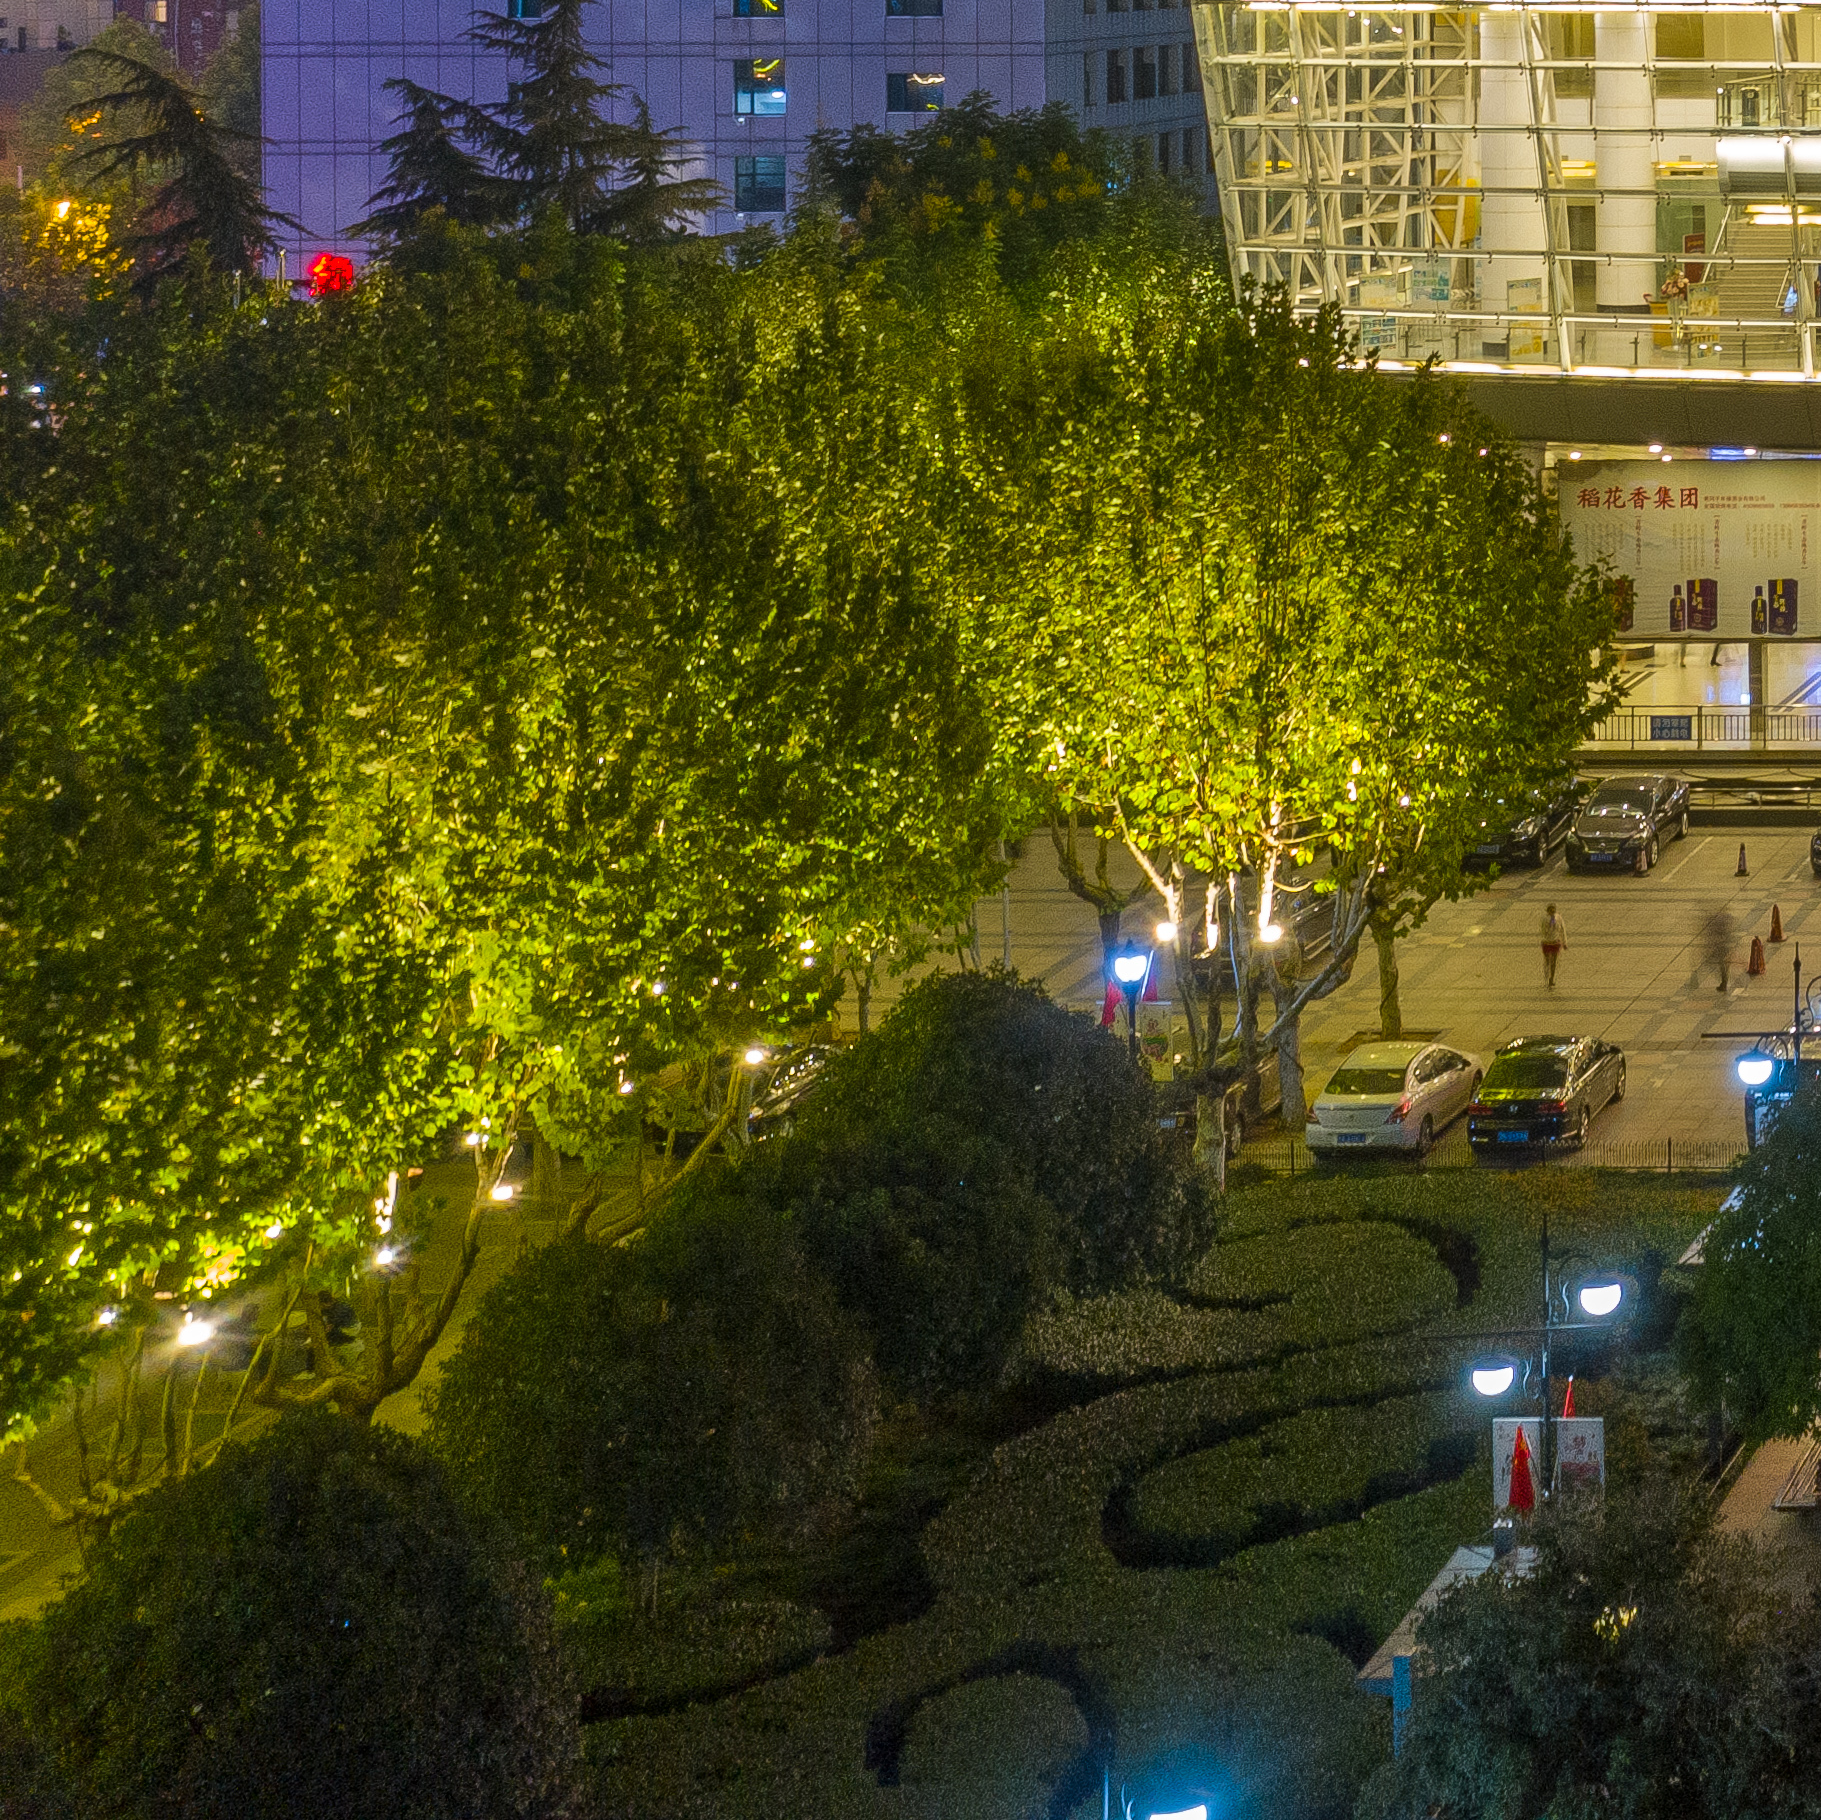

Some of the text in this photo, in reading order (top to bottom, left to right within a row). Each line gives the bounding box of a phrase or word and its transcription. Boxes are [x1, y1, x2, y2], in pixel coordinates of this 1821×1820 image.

[1577, 485, 1699, 510] 稻花香集团
